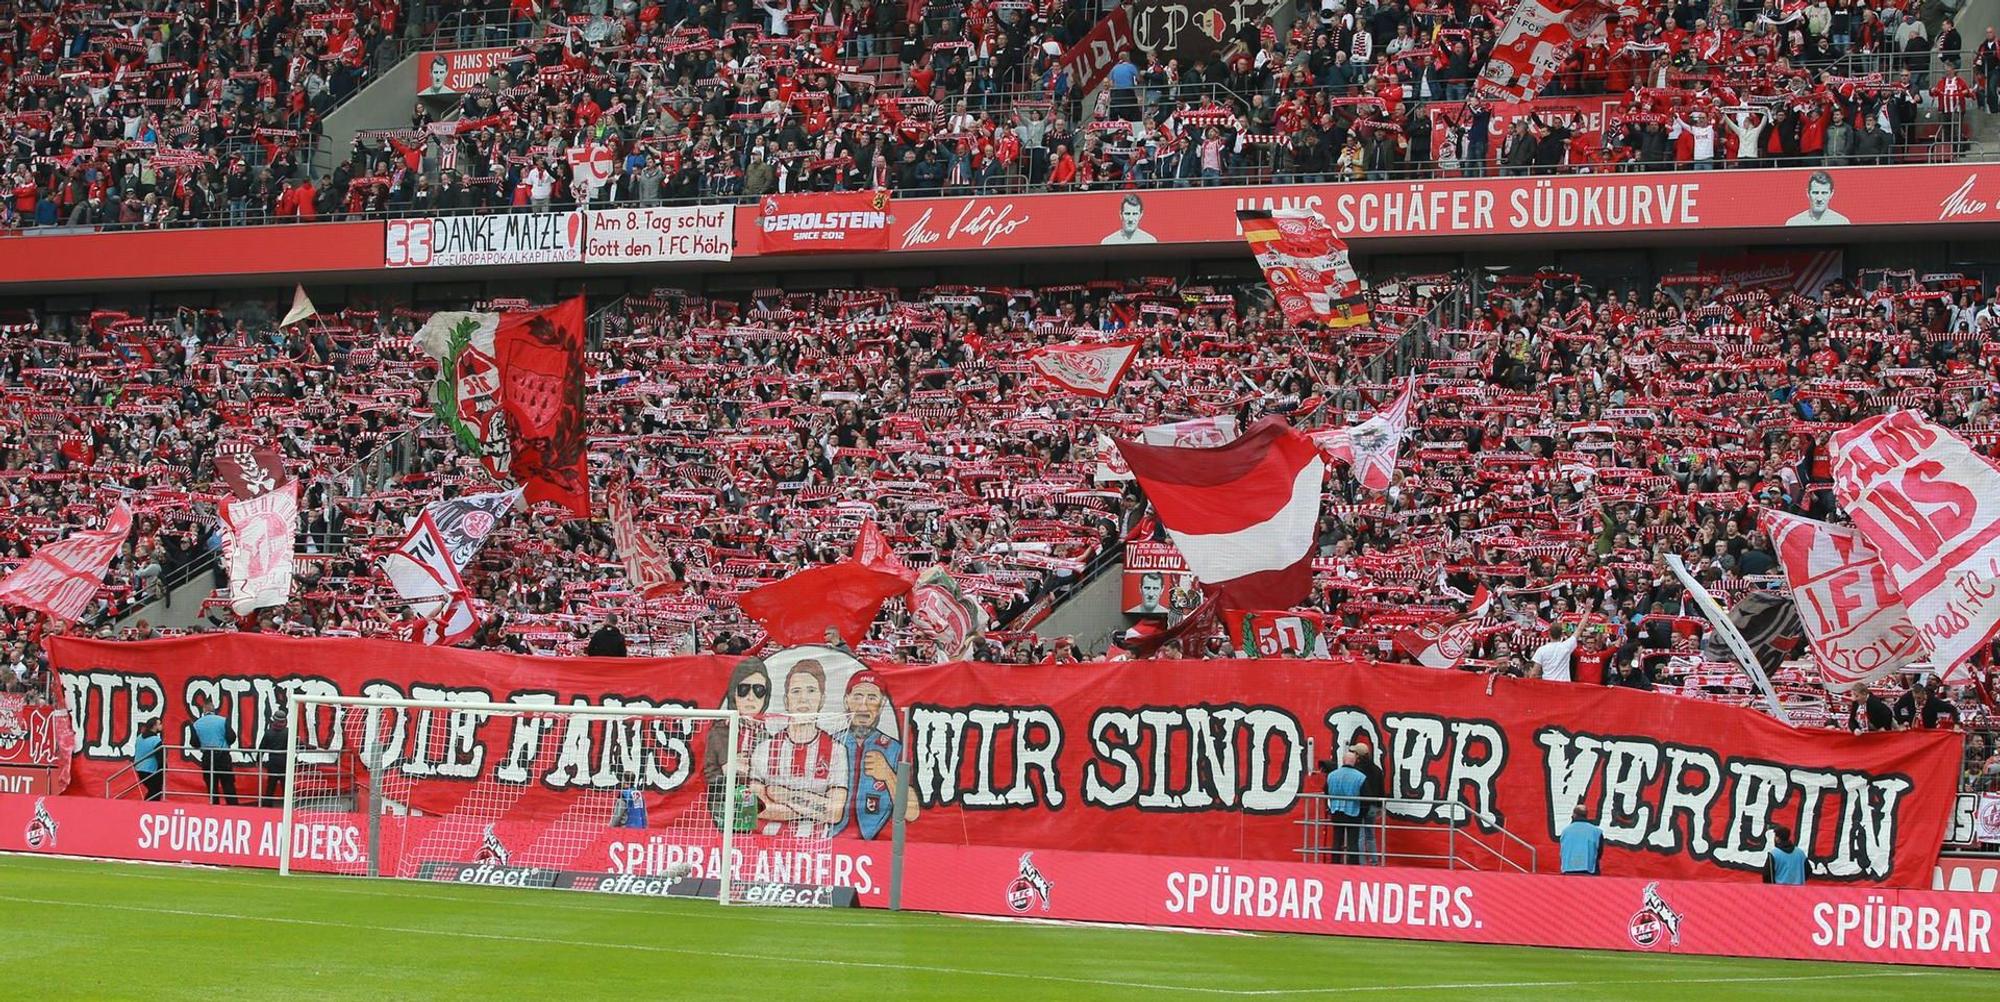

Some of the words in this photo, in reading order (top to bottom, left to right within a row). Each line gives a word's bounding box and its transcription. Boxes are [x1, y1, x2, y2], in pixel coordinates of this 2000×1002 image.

[453, 54, 483, 70] HANS
[595, 214, 621, 231] Am
[626, 214, 640, 230] 8.
[643, 211, 672, 234] Tag
[677, 209, 725, 229] schuf
[762, 211, 886, 233] GEROLSTEIN
[1337, 184, 1494, 234] SCHÄFER
[1509, 180, 1700, 229] SÜDKURVE
[388, 219, 433, 267] 33
[433, 215, 497, 255] DANKE
[588, 240, 621, 257] Gott
[624, 238, 652, 255] den
[668, 237, 689, 254] FC
[693, 236, 730, 256] Köln
[792, 231, 819, 241] SINCE
[821, 231, 845, 240] 2012
[59, 671, 165, 759] WIR
[184, 677, 344, 765] SIND
[358, 682, 491, 779] DIE
[497, 692, 693, 791] FANS
[912, 708, 1064, 807] WIR
[1086, 706, 1305, 812] SIND
[1326, 711, 1499, 828] DER
[1538, 729, 1910, 878] VEREIN
[138, 808, 251, 854] SPÜRBAR
[459, 865, 531, 887] effect
[608, 836, 744, 881] SPÜRBAR
[754, 849, 881, 895] ANDERS.
[599, 874, 673, 896] effect
[746, 882, 825, 906] effect
[1166, 866, 1324, 921] SPÜRBAR
[1334, 881, 1483, 929] ANDERS.
[1812, 895, 1992, 954] SPÜRBAR
